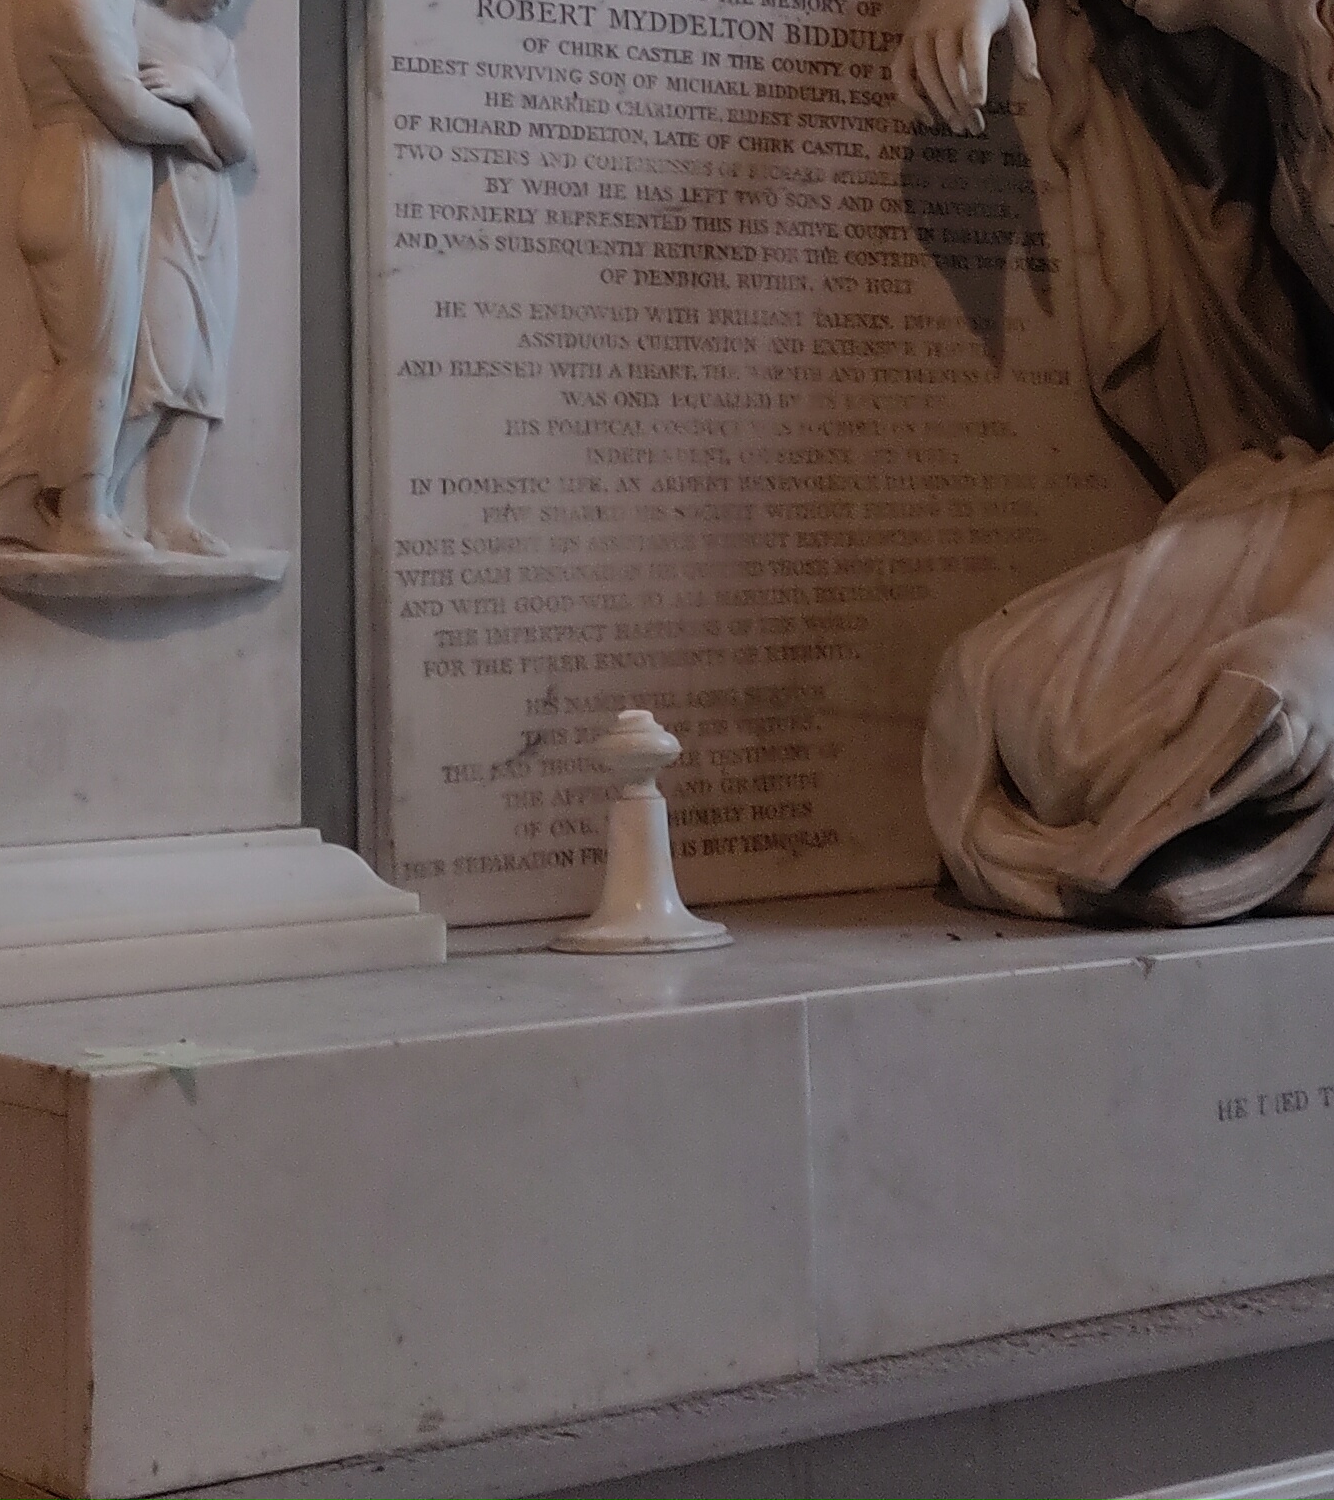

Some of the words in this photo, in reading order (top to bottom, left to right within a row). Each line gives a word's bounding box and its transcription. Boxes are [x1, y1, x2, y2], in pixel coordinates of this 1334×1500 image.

[607, 6, 775, 43] MYDDELTON
[856, 1, 883, 18] OF
[522, 36, 549, 55] OF
[558, 40, 620, 60] CHIRK
[626, 45, 693, 66] CASTLE
[701, 51, 721, 67] IN
[727, 53, 764, 71] THE
[771, 56, 843, 78] COUNTY
[849, 63, 875, 80] OF
[391, 55, 469, 77] ELDEST
[475, 61, 583, 85] SURVIVING
[588, 69, 626, 89] SON
[632, 74, 658, 90] OF
[666, 75, 750, 97] MICHAEL
[484, 91, 514, 109] HE
[521, 93, 610, 115] MARRIED
[394, 114, 421, 131] OF
[429, 115, 522, 137] RICHARD
[654, 130, 700, 148] LATE
[706, 133, 731, 150] OF
[737, 135, 795, 155] CHIRK
[877, 144, 916, 163] AND
[484, 176, 513, 195] BY
[520, 178, 589, 198] WHOM
[598, 183, 627, 200] HE
[427, 203, 539, 226] FORMERLY
[545, 208, 686, 233] REPRESENTED
[843, 223, 909, 242] COUNTY
[394, 232, 438, 250] AND
[442, 233, 490, 251] WAS
[493, 235, 645, 259] SUBSEQUENTLY
[653, 242, 757, 264] RETURNED
[1217, 1097, 1247, 1123] HE
